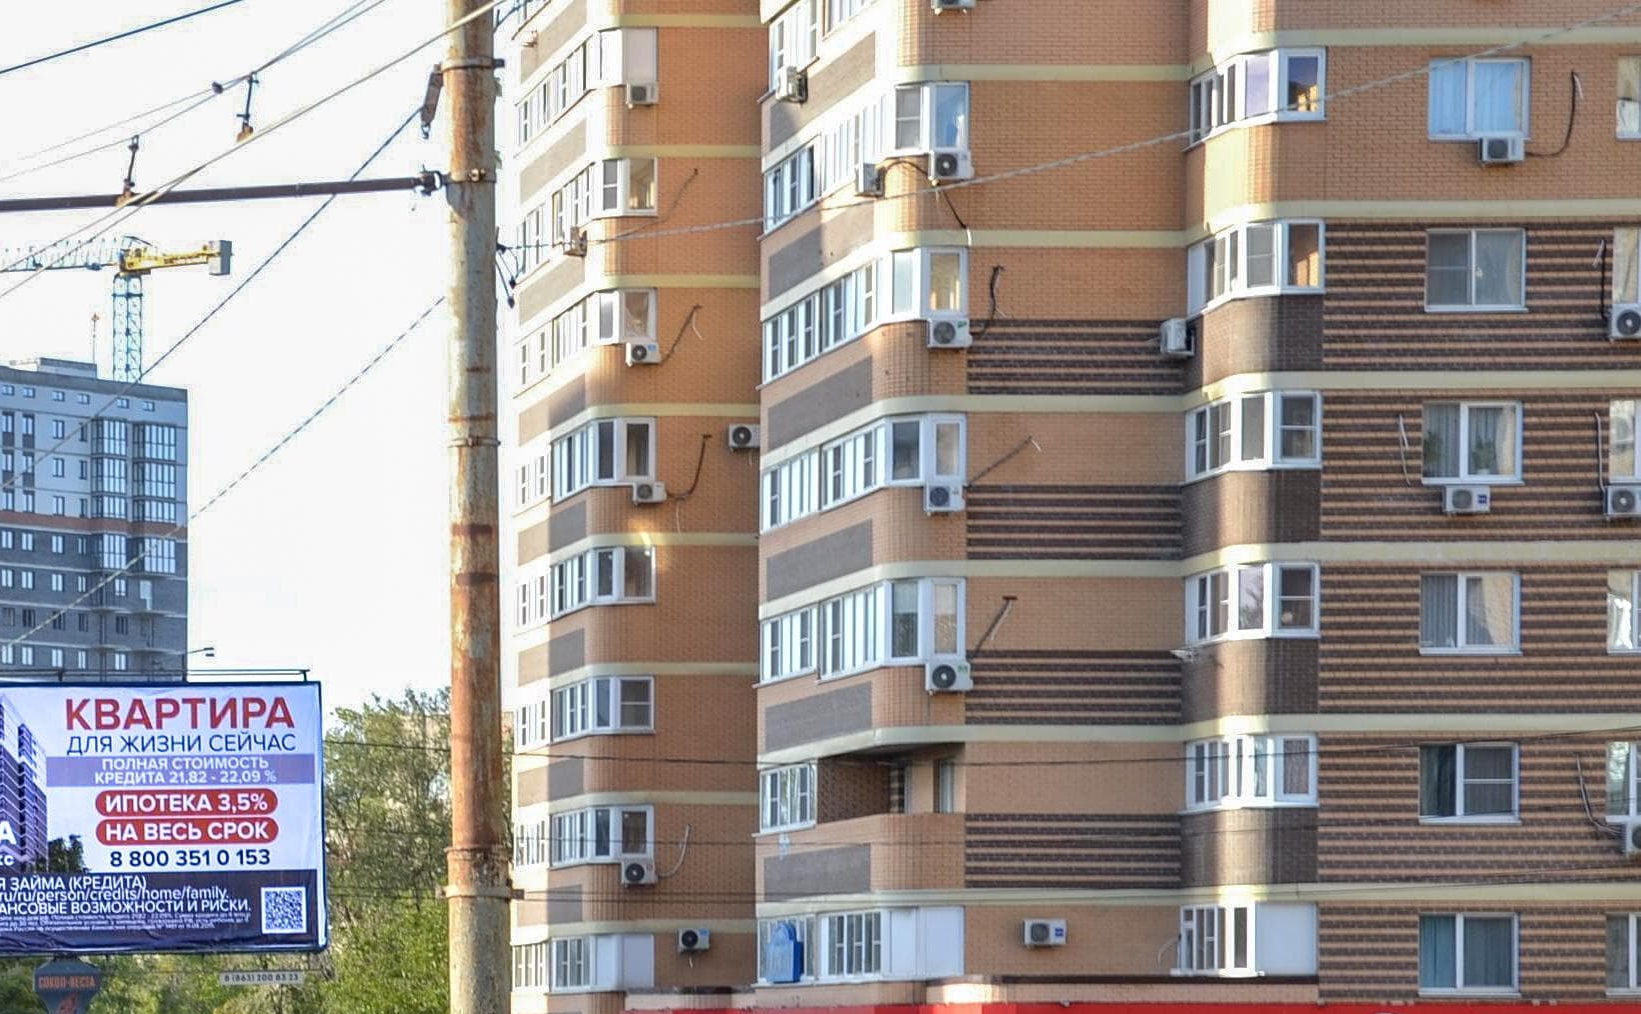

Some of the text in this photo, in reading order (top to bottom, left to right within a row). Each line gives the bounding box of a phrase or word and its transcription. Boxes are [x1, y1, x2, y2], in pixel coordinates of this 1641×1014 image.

[65, 697, 296, 731] КВАРТИРА
[66, 731, 297, 756] ДЛЯ ЖИЗНИ СЕЙЧАС
[102, 756, 270, 771] ПОЛНАЯ СТОИМОСТЬ
[94, 772, 166, 787] КРЕДИТА
[168, 771, 208, 786] 21,82
[219, 770, 260, 786] 22,09
[105, 792, 269, 814] ИПОТЕКА 3,5%
[105, 820, 270, 842] НА ВЕСЬ СРОК
[110, 848, 271, 867] 8 800 351 0 153
[9, 874, 65, 892] ЗАЙМА
[69, 875, 148, 892] (КРЕДИТА)
[70, 900, 185, 915] ВОЗМОЖНОСТИ
[187, 899, 198, 913] И
[201, 898, 252, 913] РИСКИ.
